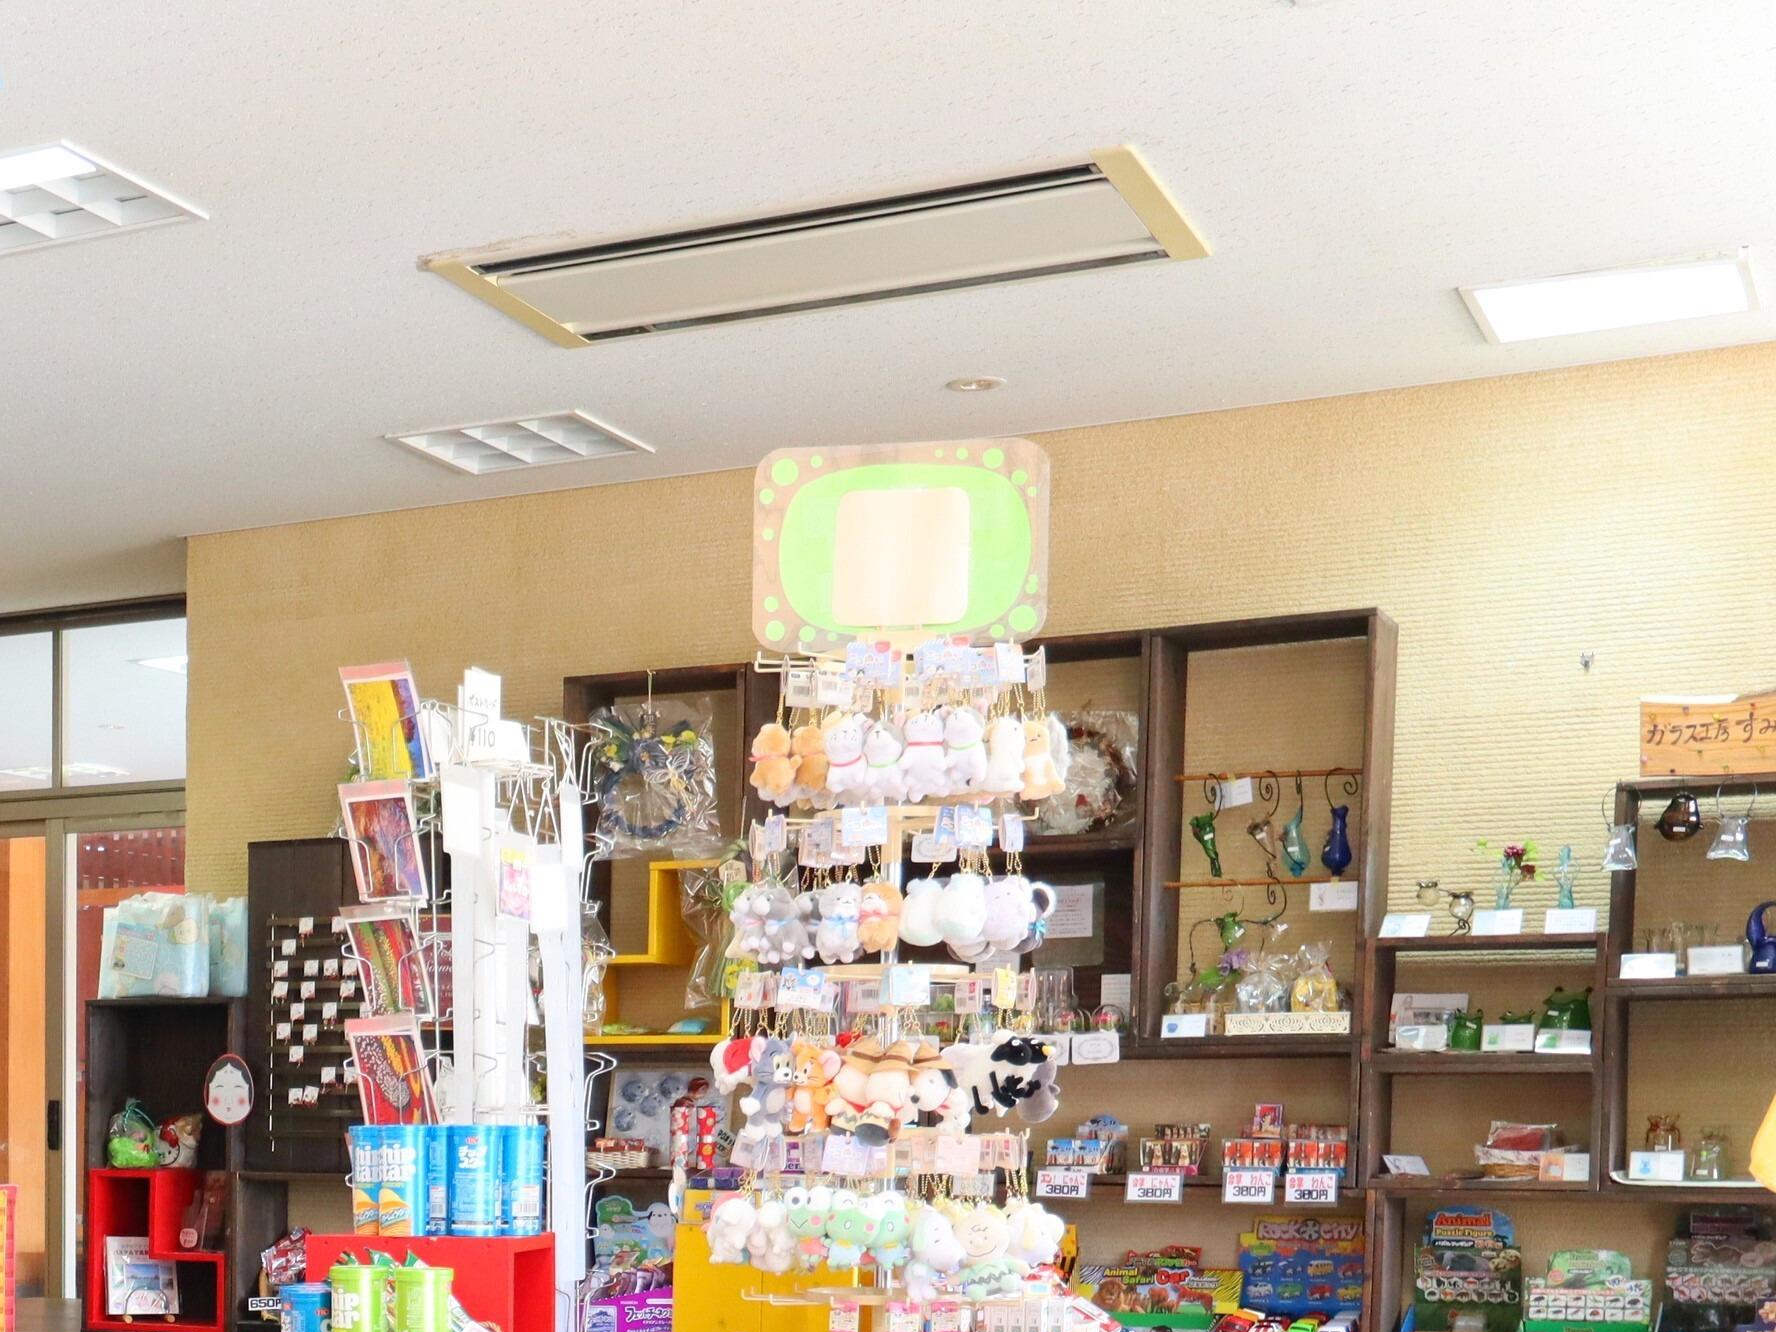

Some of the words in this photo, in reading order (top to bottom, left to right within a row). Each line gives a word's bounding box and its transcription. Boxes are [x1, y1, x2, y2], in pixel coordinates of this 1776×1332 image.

[1646, 718, 1730, 746] ガラス工房
[1045, 1184, 1079, 1195] 380円
[1137, 1188, 1172, 1198] 380円
[1233, 1186, 1266, 1197] 380円
[1294, 1189, 1328, 1200] 380円
[1434, 1213, 1492, 1227] Animal
[1435, 1228, 1463, 1237] Puzzle
[1465, 1228, 1493, 1238] Figure
[1103, 1267, 1138, 1277] Animal
[1155, 1268, 1191, 1286] Car
[1123, 1275, 1155, 1285] Safari
